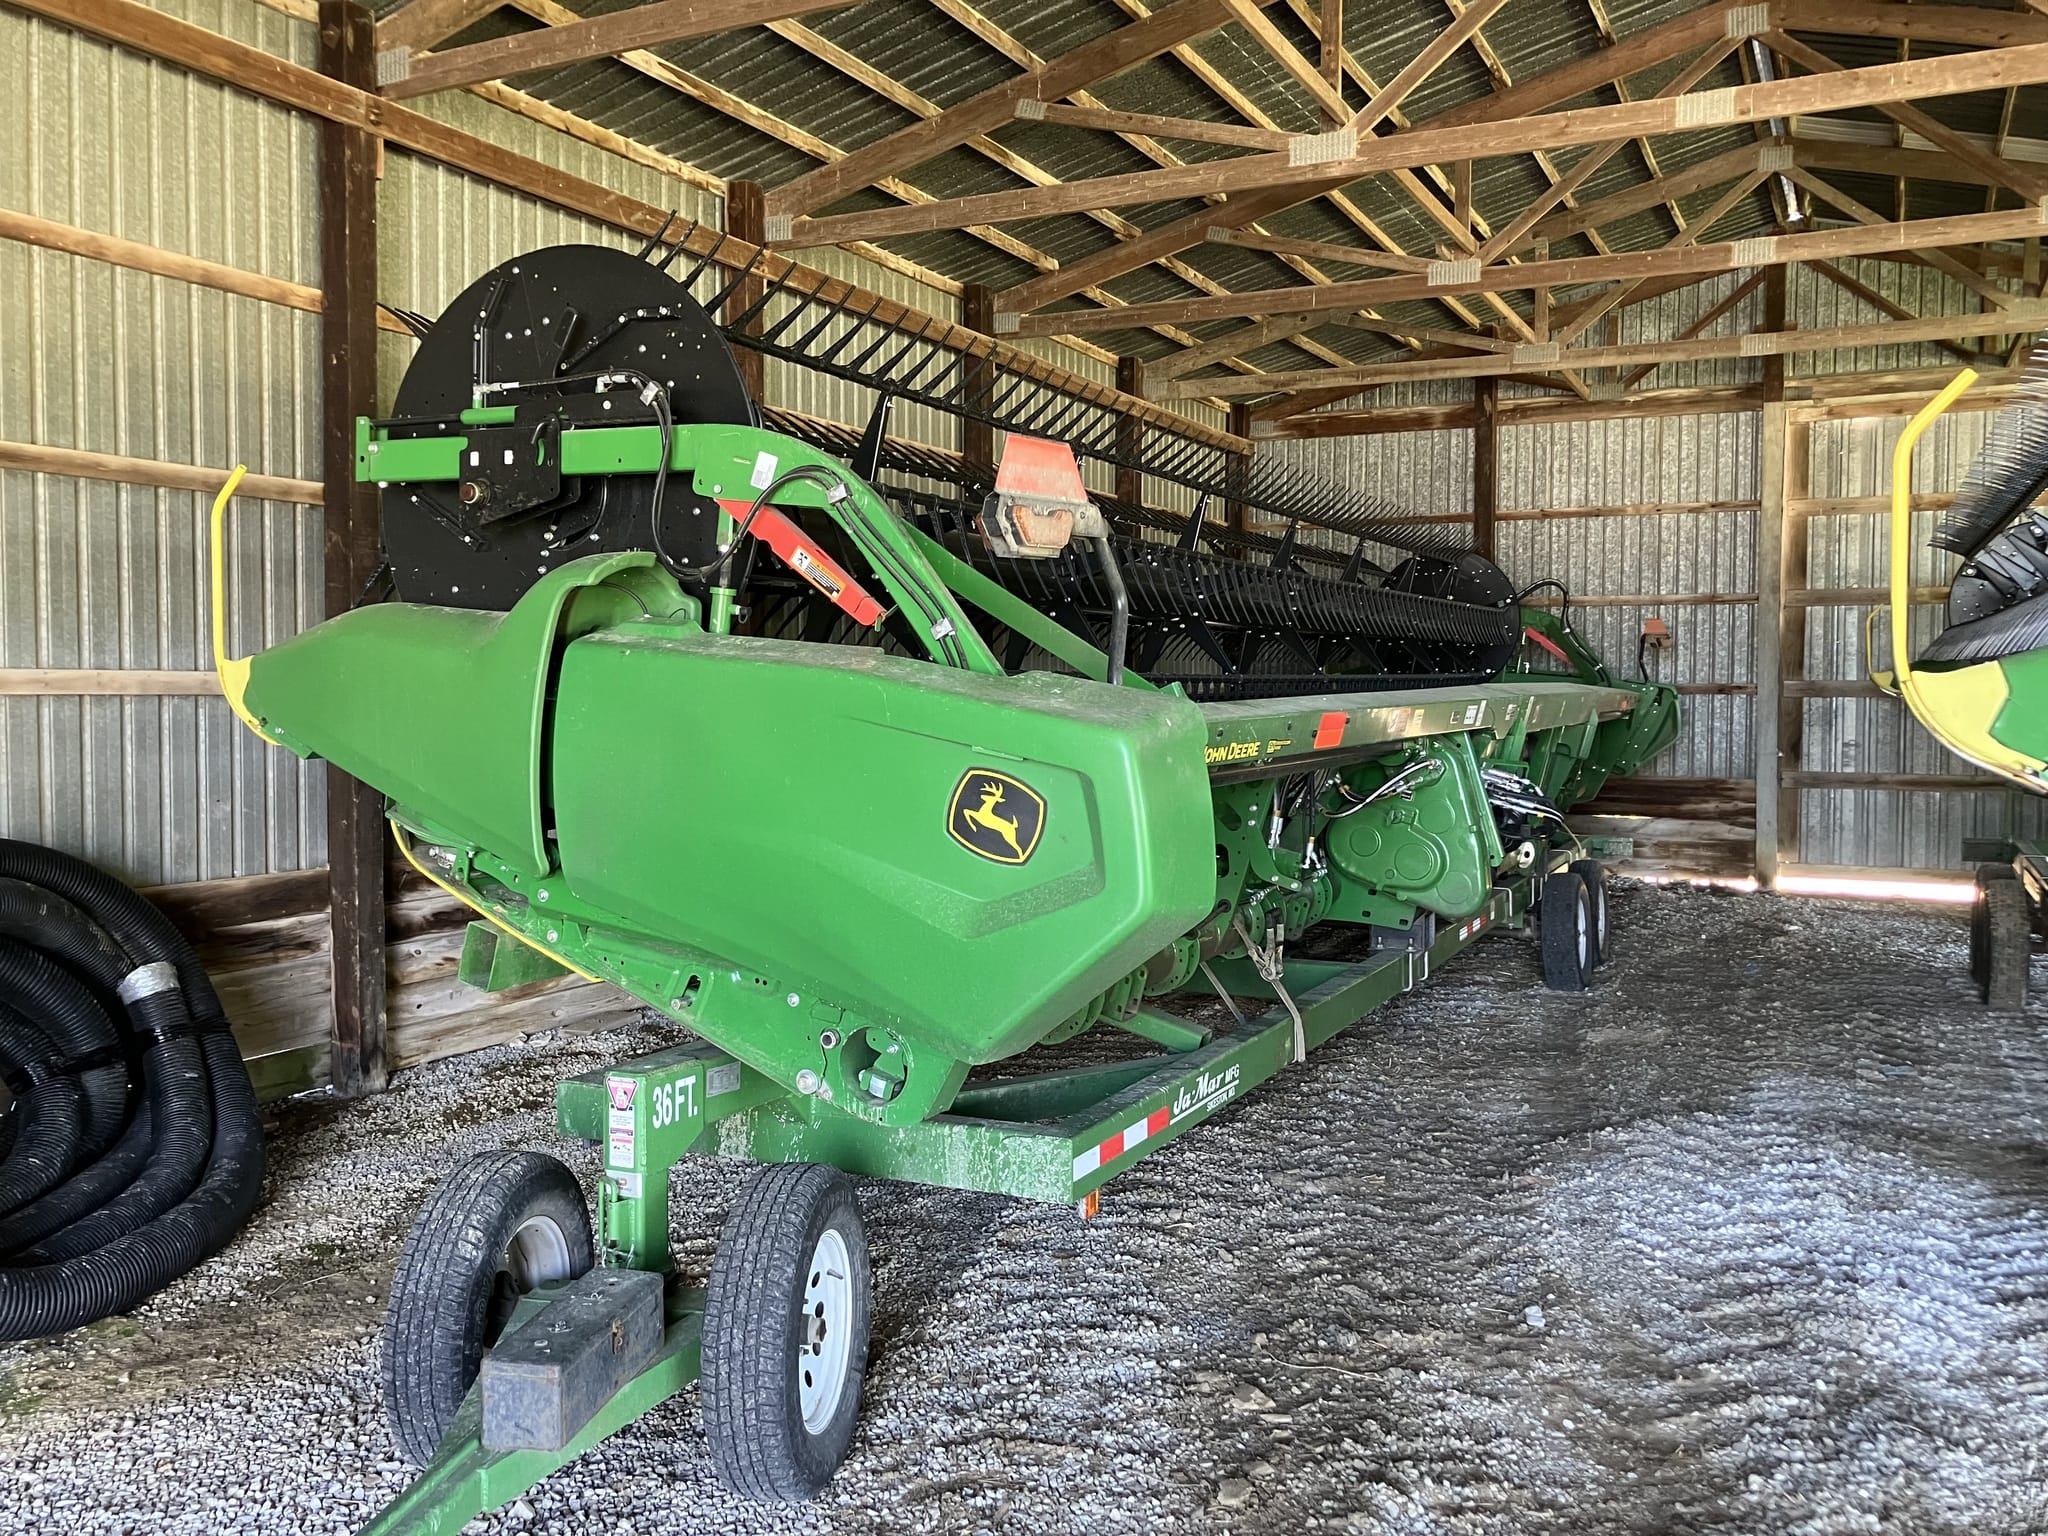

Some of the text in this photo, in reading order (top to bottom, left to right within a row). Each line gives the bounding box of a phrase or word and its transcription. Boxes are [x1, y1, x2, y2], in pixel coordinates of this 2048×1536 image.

[1227, 742, 1261, 760] DEERE
[1225, 1063, 1240, 1084] MFG
[652, 1083, 673, 1129] 36
[675, 1075, 698, 1122] FT.
